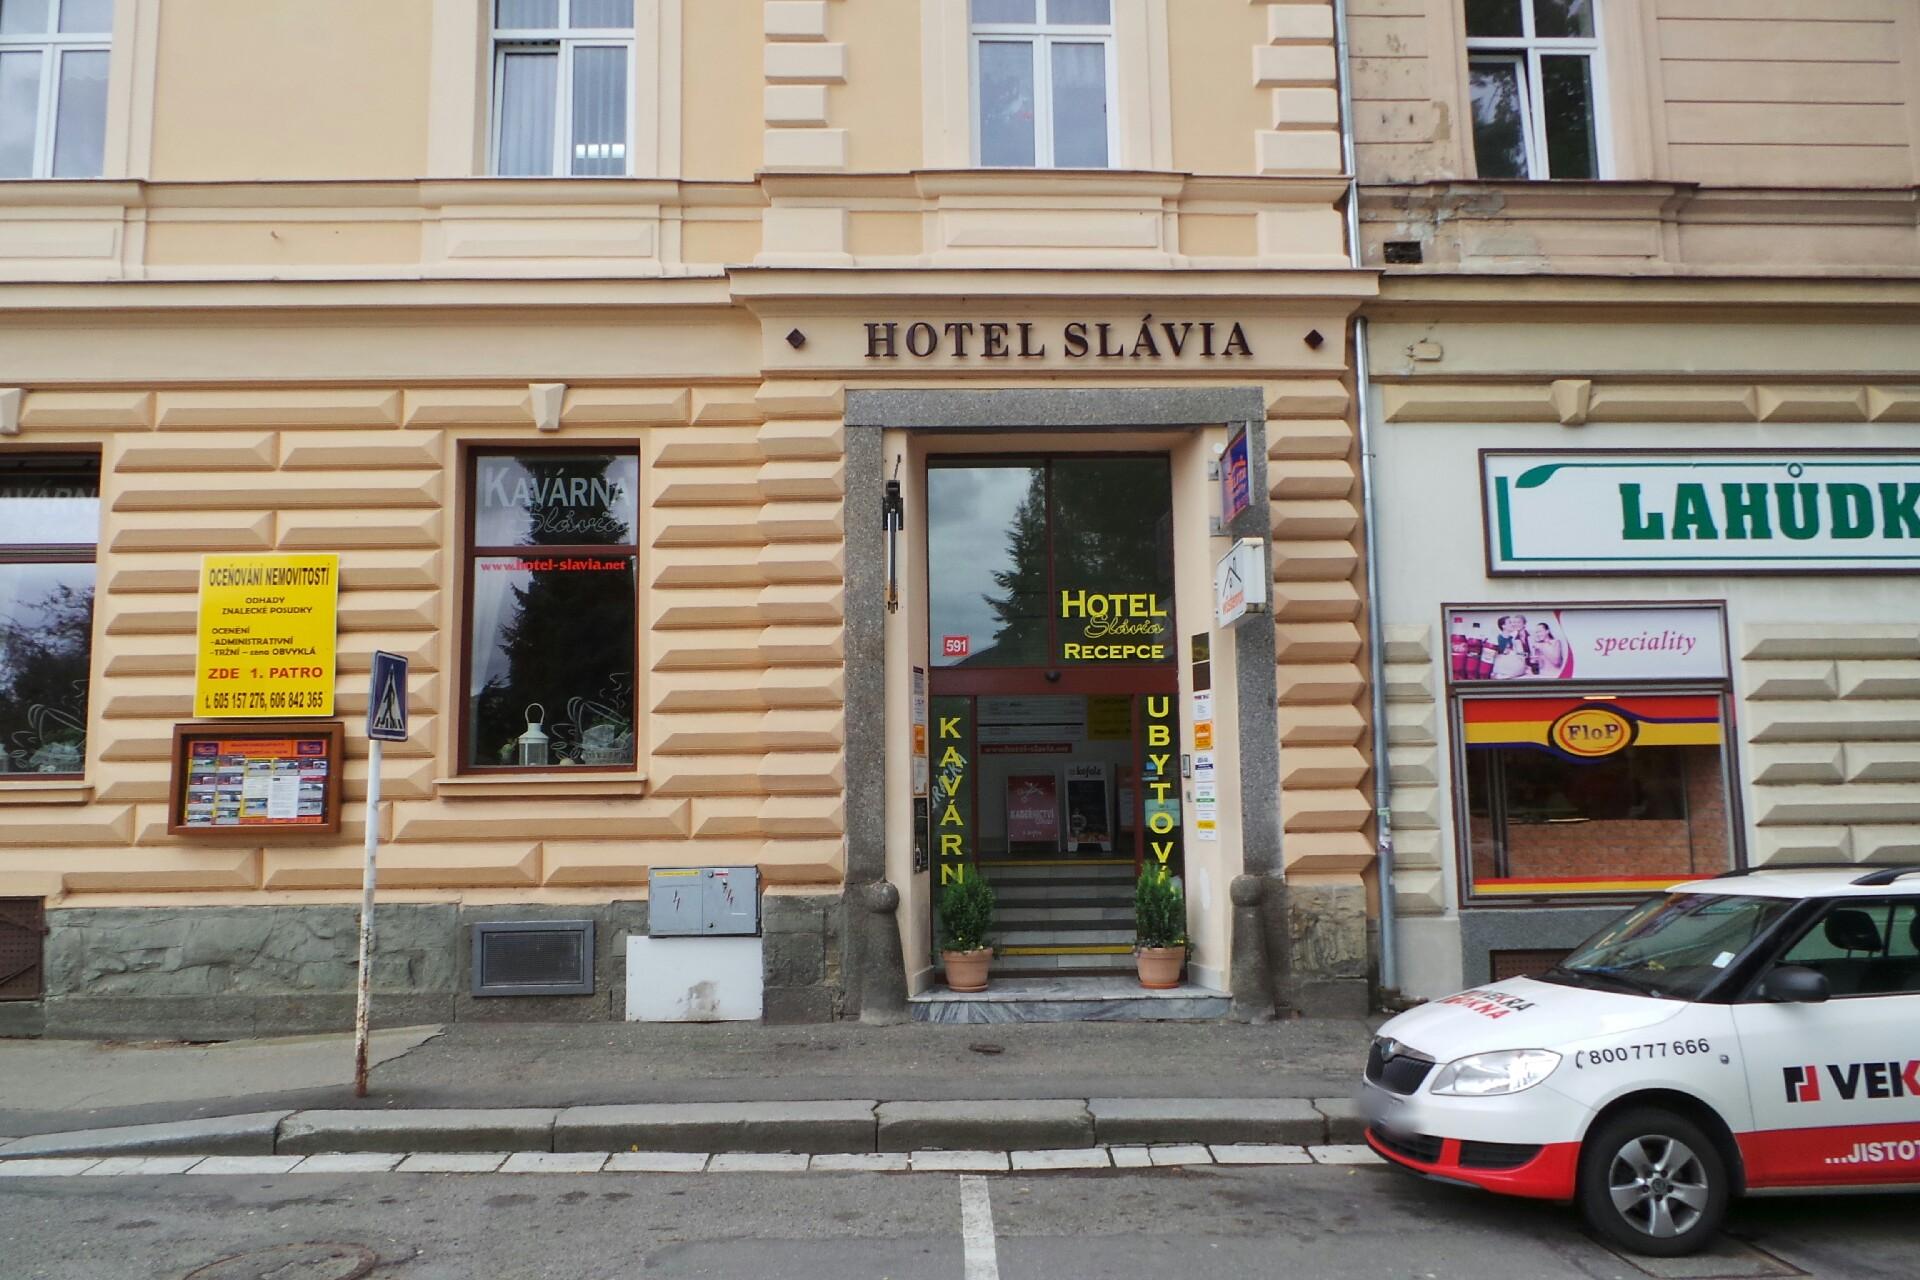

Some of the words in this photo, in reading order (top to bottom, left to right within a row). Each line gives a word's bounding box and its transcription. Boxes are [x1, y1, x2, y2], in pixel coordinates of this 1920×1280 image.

[863, 321, 1045, 358] HOTEL
[1063, 313, 1254, 358] SLÁVIA
[484, 466, 632, 507] KAVÁRNA
[1618, 462, 1920, 541] LAHŮDK
[480, 557, 626, 571] www.hotel-slavia.net
[245, 596, 286, 604] ODHADY
[1061, 590, 1168, 619] HOTEL
[945, 639, 967, 653] 591
[1064, 643, 1165, 660] RECEPCE
[1594, 631, 1697, 657] speciality
[207, 668, 240, 680] ZDE
[250, 667, 264, 679] 1.
[269, 667, 324, 679] PATRO
[213, 692, 229, 709] 605
[232, 692, 247, 708] 157
[270, 692, 286, 708] 606
[288, 691, 304, 708] 842
[307, 691, 323, 708] 365
[1566, 723, 1621, 743] FloP
[1674, 1038, 1711, 1056] 666
